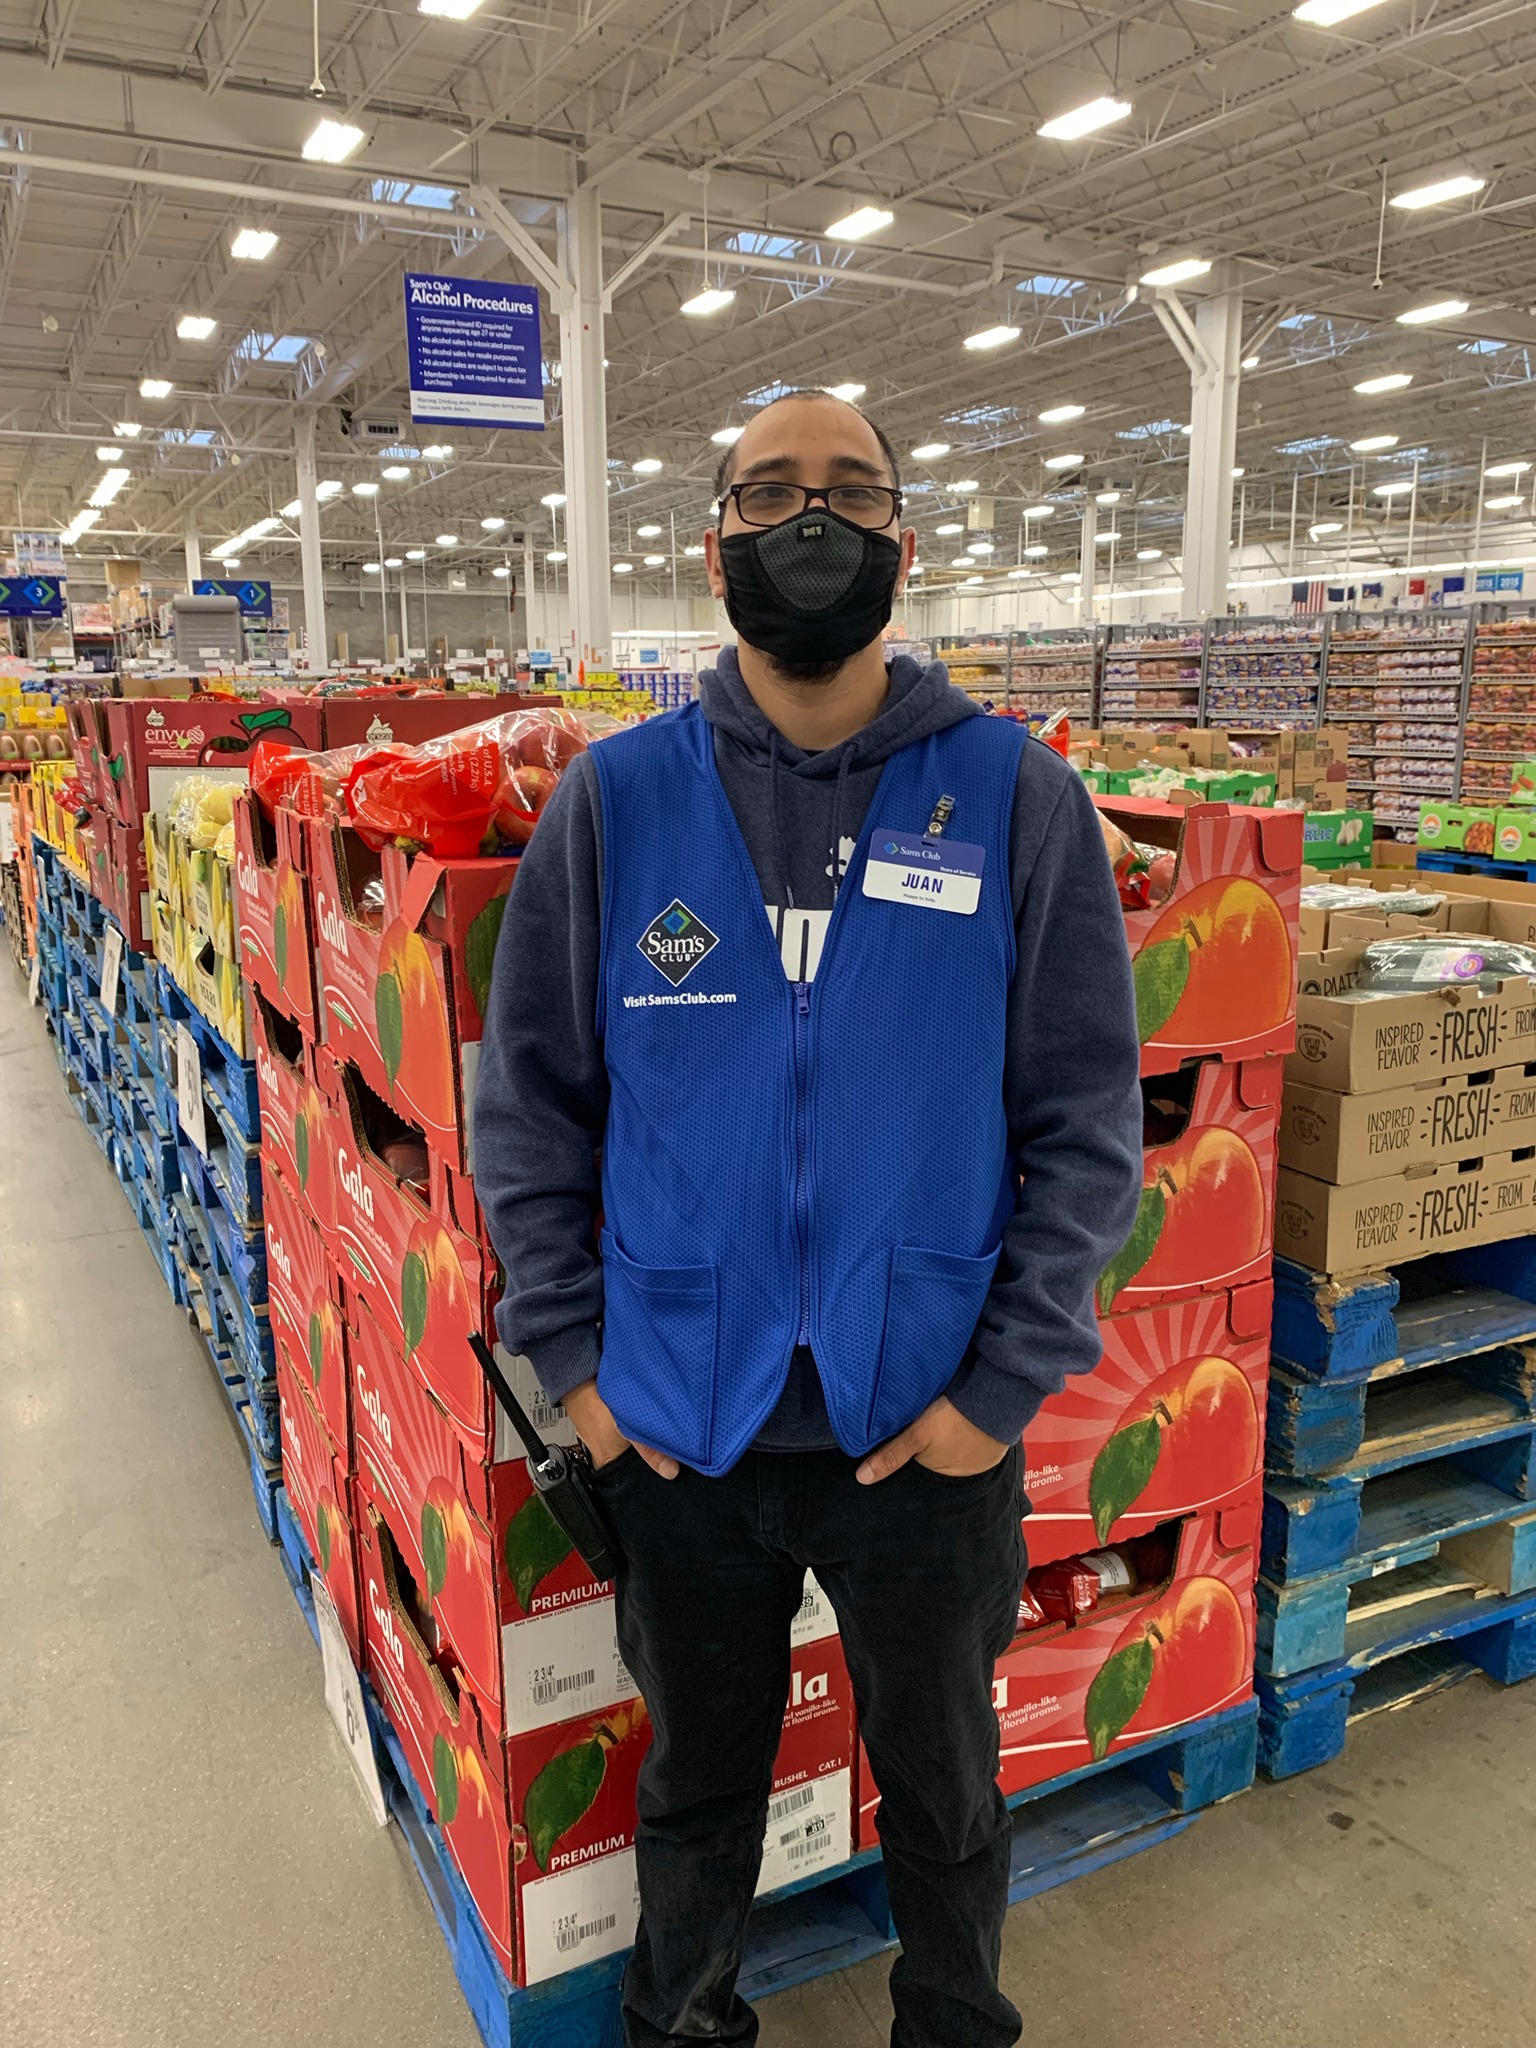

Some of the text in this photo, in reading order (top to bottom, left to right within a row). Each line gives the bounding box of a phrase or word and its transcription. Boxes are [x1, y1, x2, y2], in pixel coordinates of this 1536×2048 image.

[410, 279, 432, 290] Sam's
[411, 289, 534, 314] Alcohol Procedures
[420, 316, 514, 332] Government-issued ID required for
[420, 325, 442, 333] anyone
[442, 327, 470, 336] appearing
[470, 329, 481, 337] age
[495, 331, 512, 339] under
[421, 335, 525, 351] No alcohol sales to intoxicated persons
[422, 347, 518, 362] No alcohol sales for resale purposes
[423, 358, 431, 366] All
[431, 359, 452, 368] alcohol
[452, 361, 467, 369] sales
[477, 363, 497, 372] subject
[503, 365, 518, 373] sales
[517, 366, 527, 374] tax
[423, 370, 460, 381] Membership
[475, 375, 498, 383] required
[498, 375, 507, 383] for
[506, 376, 527, 385] alcohol
[423, 378, 453, 387] purchases
[35, 587, 43, 597] 3
[249, 589, 255, 598] 1
[144, 728, 186, 749] envy
[483, 749, 492, 759] of
[1304, 828, 1333, 842] RLIC
[922, 850, 941, 861] Club
[237, 851, 259, 899] Gala
[940, 866, 953, 874] Years
[959, 869, 976, 877] Service
[901, 873, 944, 894] JUAN
[317, 891, 349, 958] Gala
[647, 931, 705, 955] Sam's
[660, 953, 694, 963] CLUB
[623, 991, 737, 1008] Visit SamsClub.com
[1375, 1021, 1424, 1050] INSPIRED
[1441, 1003, 1499, 1065] FRESH
[1377, 1043, 1421, 1071] FLAVOR
[257, 1045, 279, 1098] Gala
[1367, 1087, 1536, 1147] INSPIRED FRESH FROM
[1369, 1127, 1411, 1155] FLAVOR
[338, 1147, 375, 1222] Gala
[1354, 1180, 1523, 1241] INSPIRED FRESH FROM
[1356, 1222, 1400, 1250] FLAVOR
[267, 1222, 292, 1283] Gala
[356, 1364, 393, 1450] Gala
[534, 1390, 540, 1404] 2
[1023, 1465, 1059, 1481] illa-like
[1031, 1474, 1063, 1488] aroma.
[531, 1580, 609, 1613] PREMIUM
[554, 1607, 573, 1616] COATED
[588, 1599, 602, 1607] FOOD
[368, 1578, 405, 1673] Gala
[791, 1670, 828, 1707] la
[784, 1698, 837, 1721] nd vanilla-like
[792, 1712, 812, 1726] floral
[813, 1704, 840, 1718] aroma.
[1003, 1713, 1028, 1731] floral
[1029, 1703, 1062, 1720] aroma.
[1007, 1695, 1058, 1719] vanilla-like
[774, 1770, 809, 1788] BUSHEL
[818, 1759, 837, 1772] CAT.
[550, 1833, 625, 1871] PREMIUM
